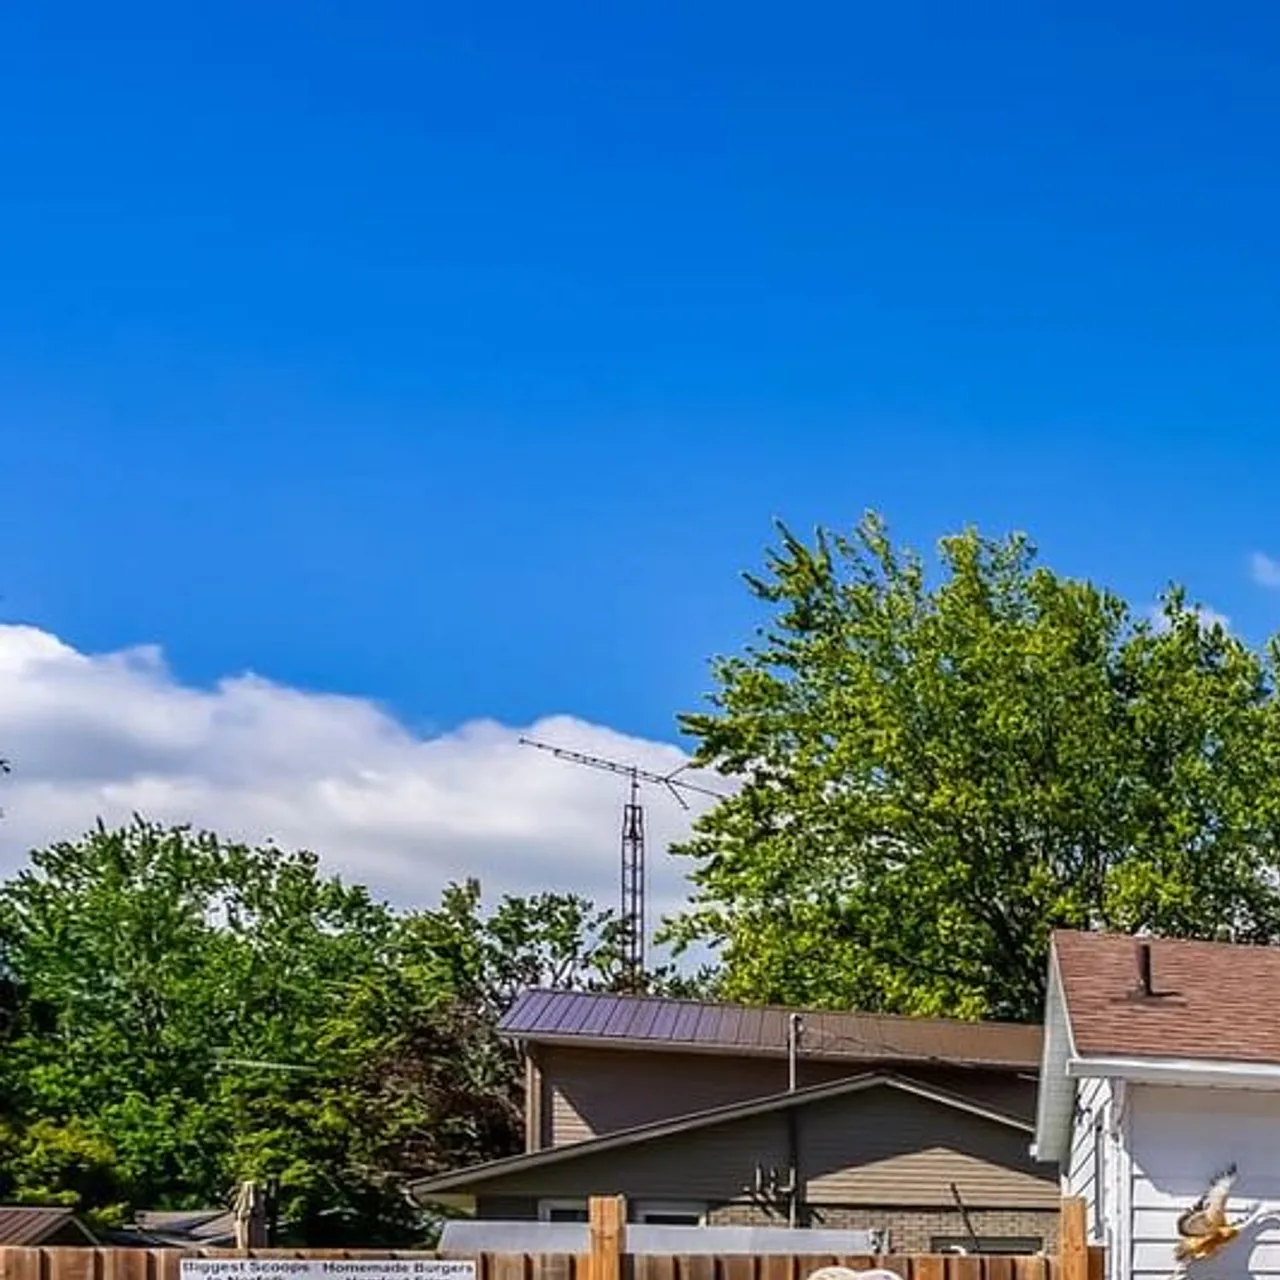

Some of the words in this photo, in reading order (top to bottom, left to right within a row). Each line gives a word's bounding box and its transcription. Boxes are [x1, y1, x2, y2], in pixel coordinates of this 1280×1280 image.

[183, 1262, 245, 1274] Biggest
[250, 1262, 309, 1273] Scoops
[323, 1263, 408, 1273] Homemade
[414, 1263, 473, 1275] Burgers
